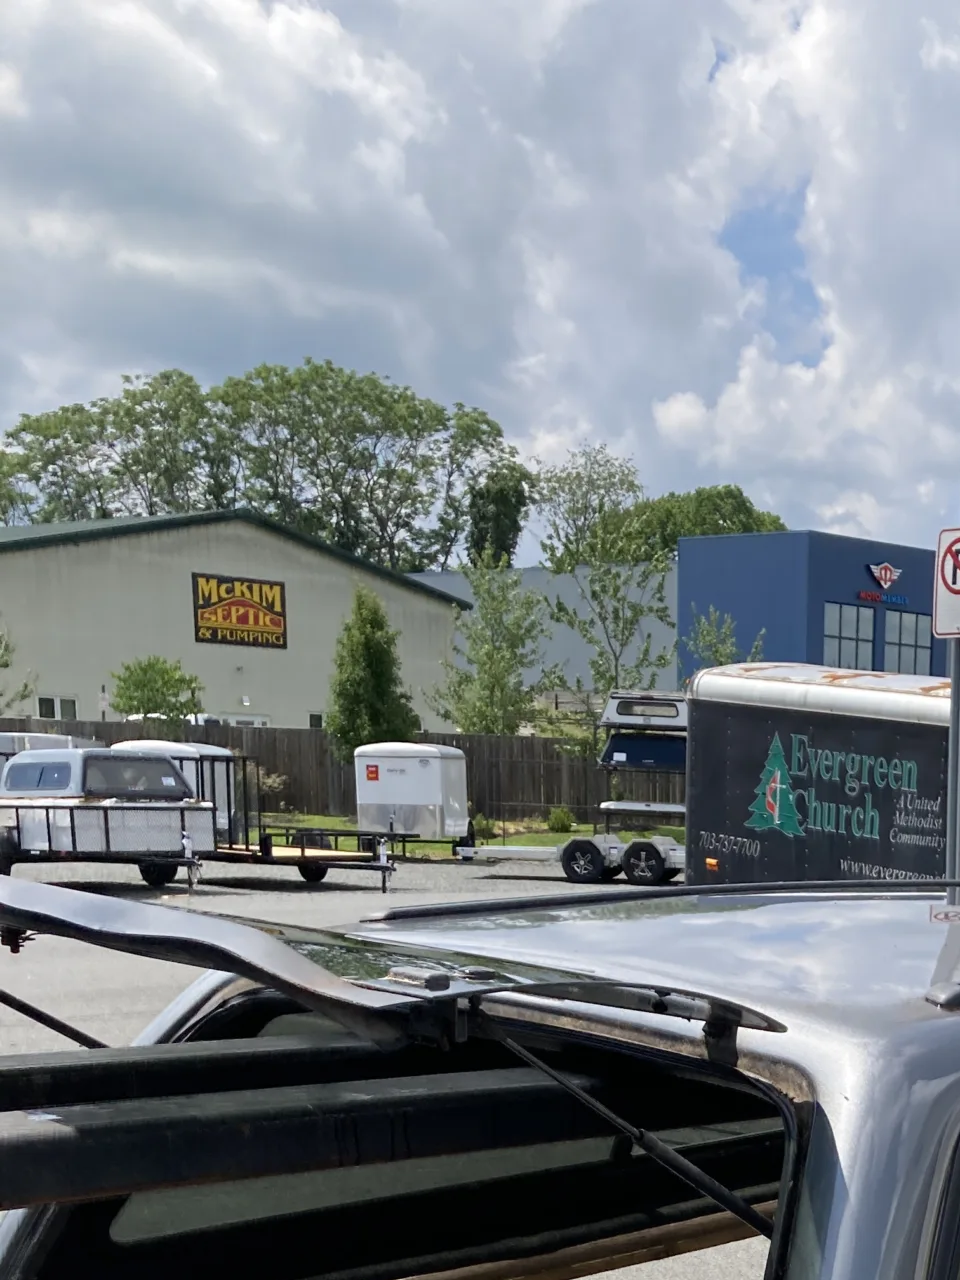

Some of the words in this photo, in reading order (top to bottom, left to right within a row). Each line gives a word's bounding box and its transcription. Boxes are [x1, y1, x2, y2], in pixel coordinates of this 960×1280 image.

[200, 605, 282, 628] SEPTIC
[199, 627, 212, 639] &
[217, 629, 283, 645] PUMPING
[789, 733, 917, 796] Evergreen
[791, 787, 880, 839] Church
[906, 794, 941, 813] United
[893, 810, 943, 829] Methodist
[700, 830, 760, 857] 703-737-7700
[889, 827, 946, 849] Community
